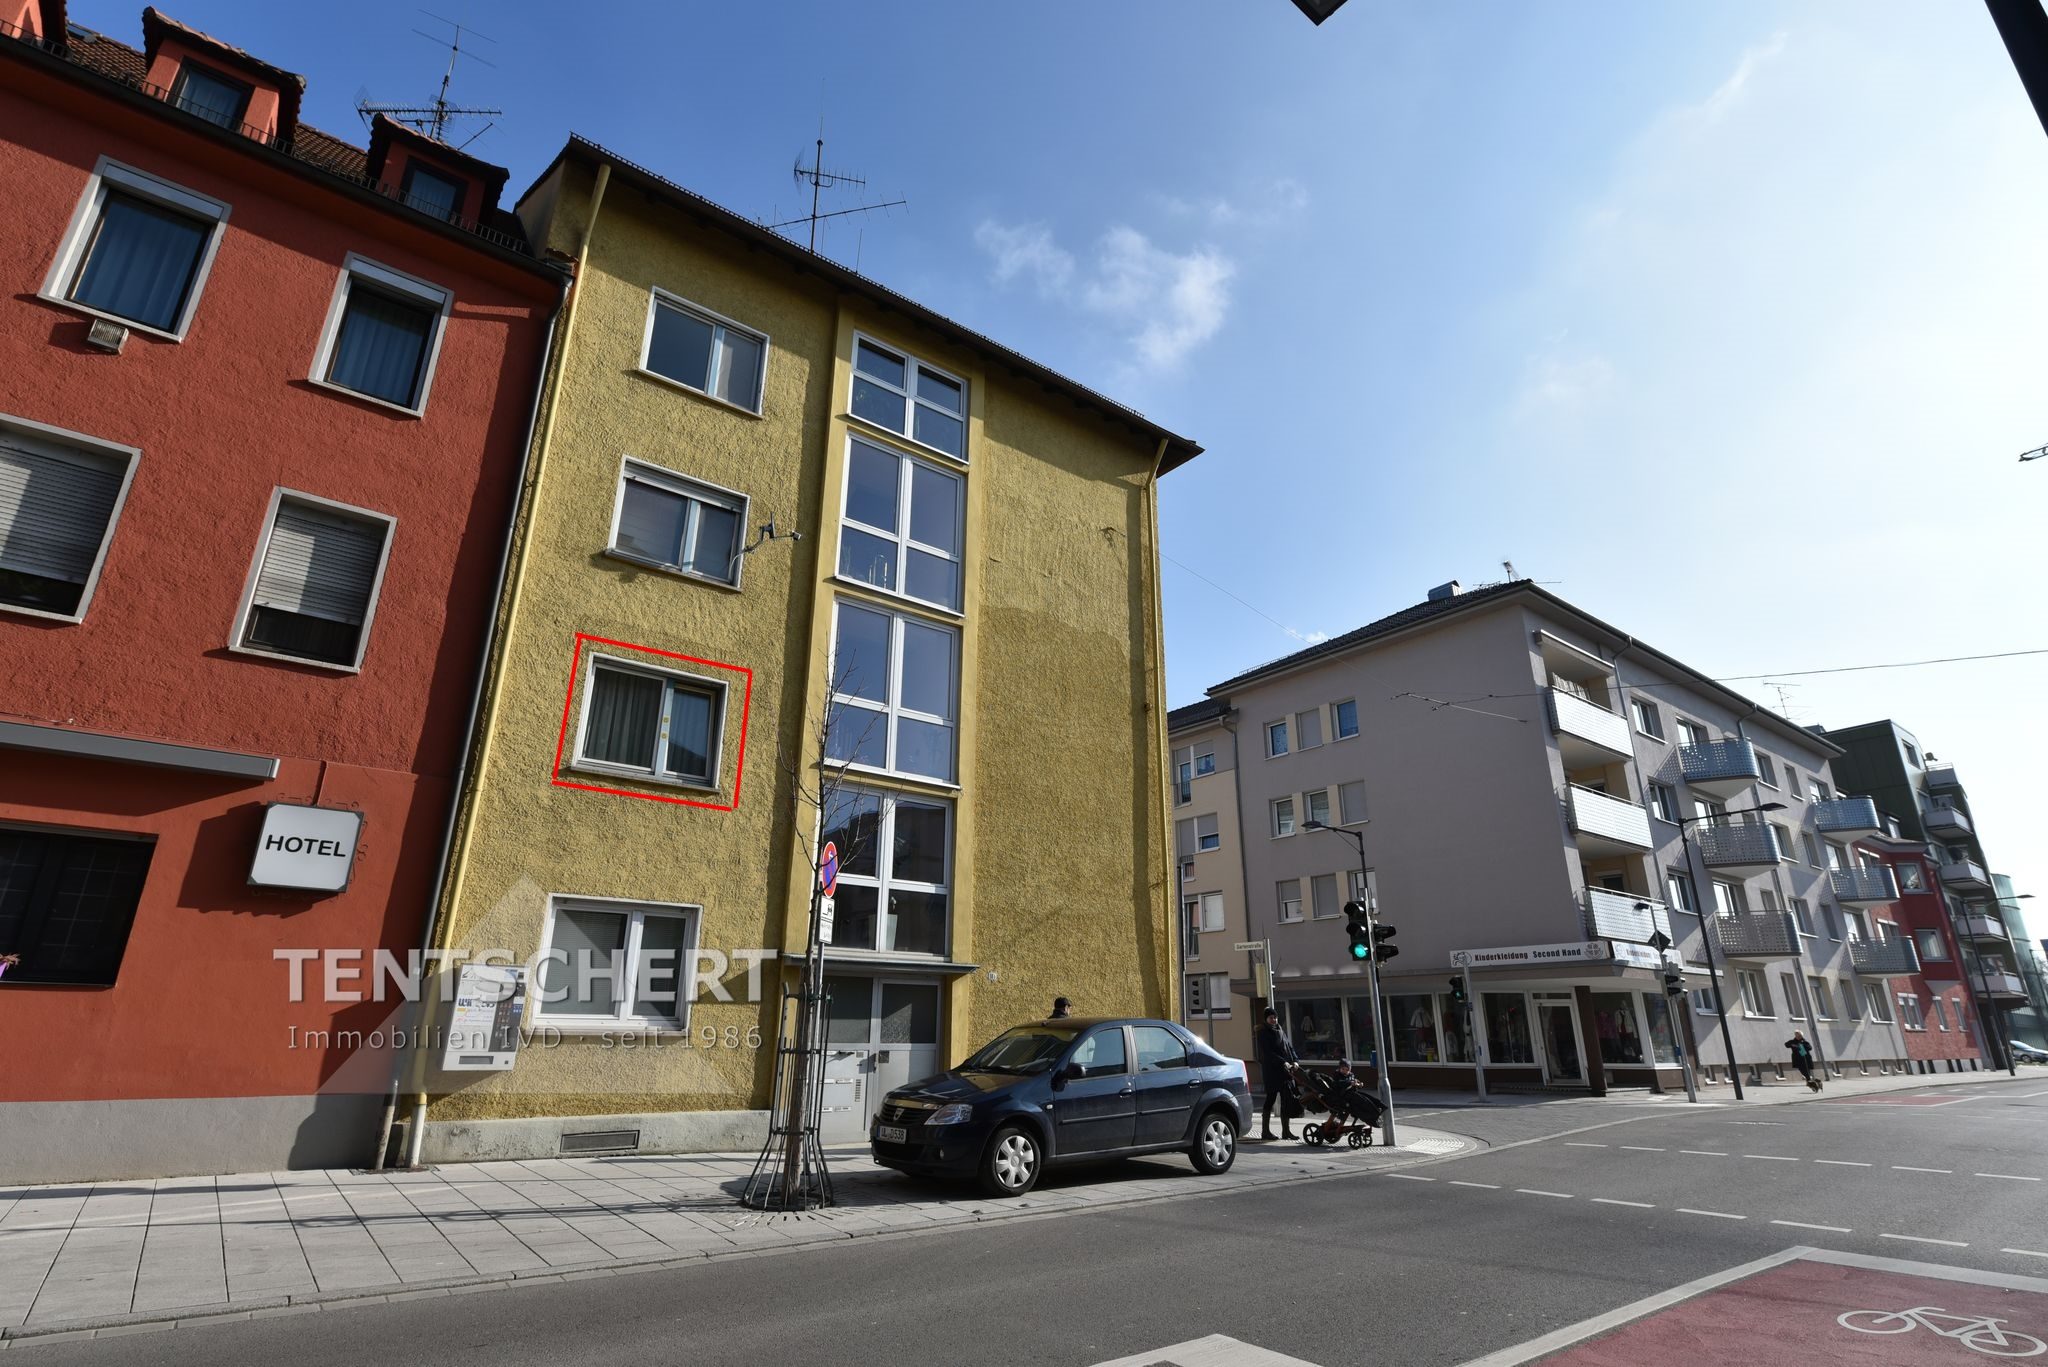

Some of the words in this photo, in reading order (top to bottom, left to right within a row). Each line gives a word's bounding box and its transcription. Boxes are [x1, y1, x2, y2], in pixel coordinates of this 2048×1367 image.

[265, 834, 346, 857] HOTEL
[1475, 951, 1528, 961] Kinderkleidung
[1532, 950, 1560, 958] Second
[1562, 948, 1581, 957] Hand
